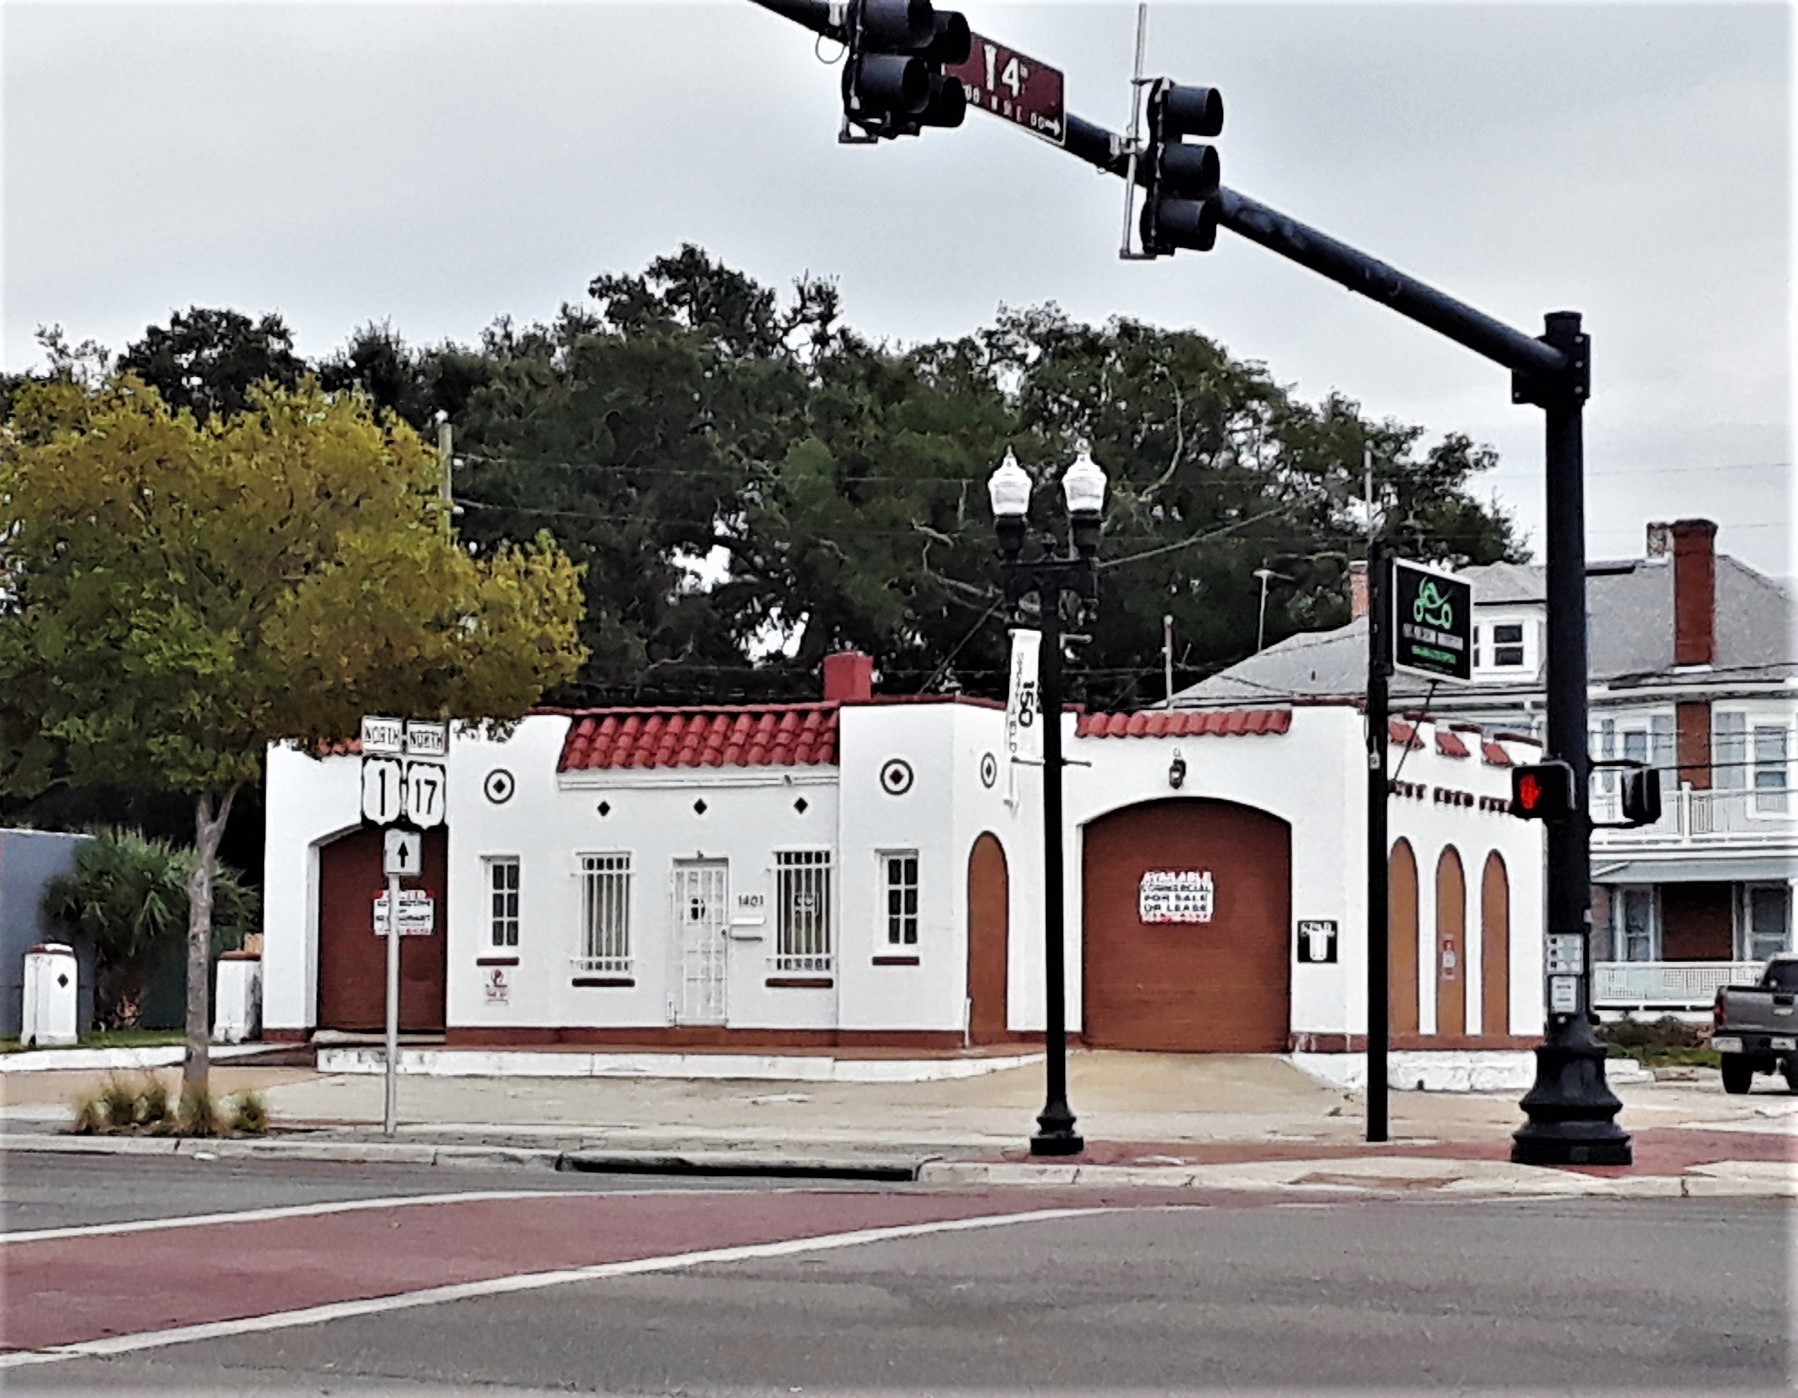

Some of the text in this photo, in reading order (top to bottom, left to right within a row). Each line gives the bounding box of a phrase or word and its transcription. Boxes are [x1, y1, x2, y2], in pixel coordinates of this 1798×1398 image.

[1018, 681, 1035, 728] 150
[379, 767, 386, 818] 1
[415, 778, 438, 815] 17
[738, 894, 764, 907] 1401
[1144, 893, 1207, 902] FOR SALE
[1144, 903, 1207, 912] OR LEASE
